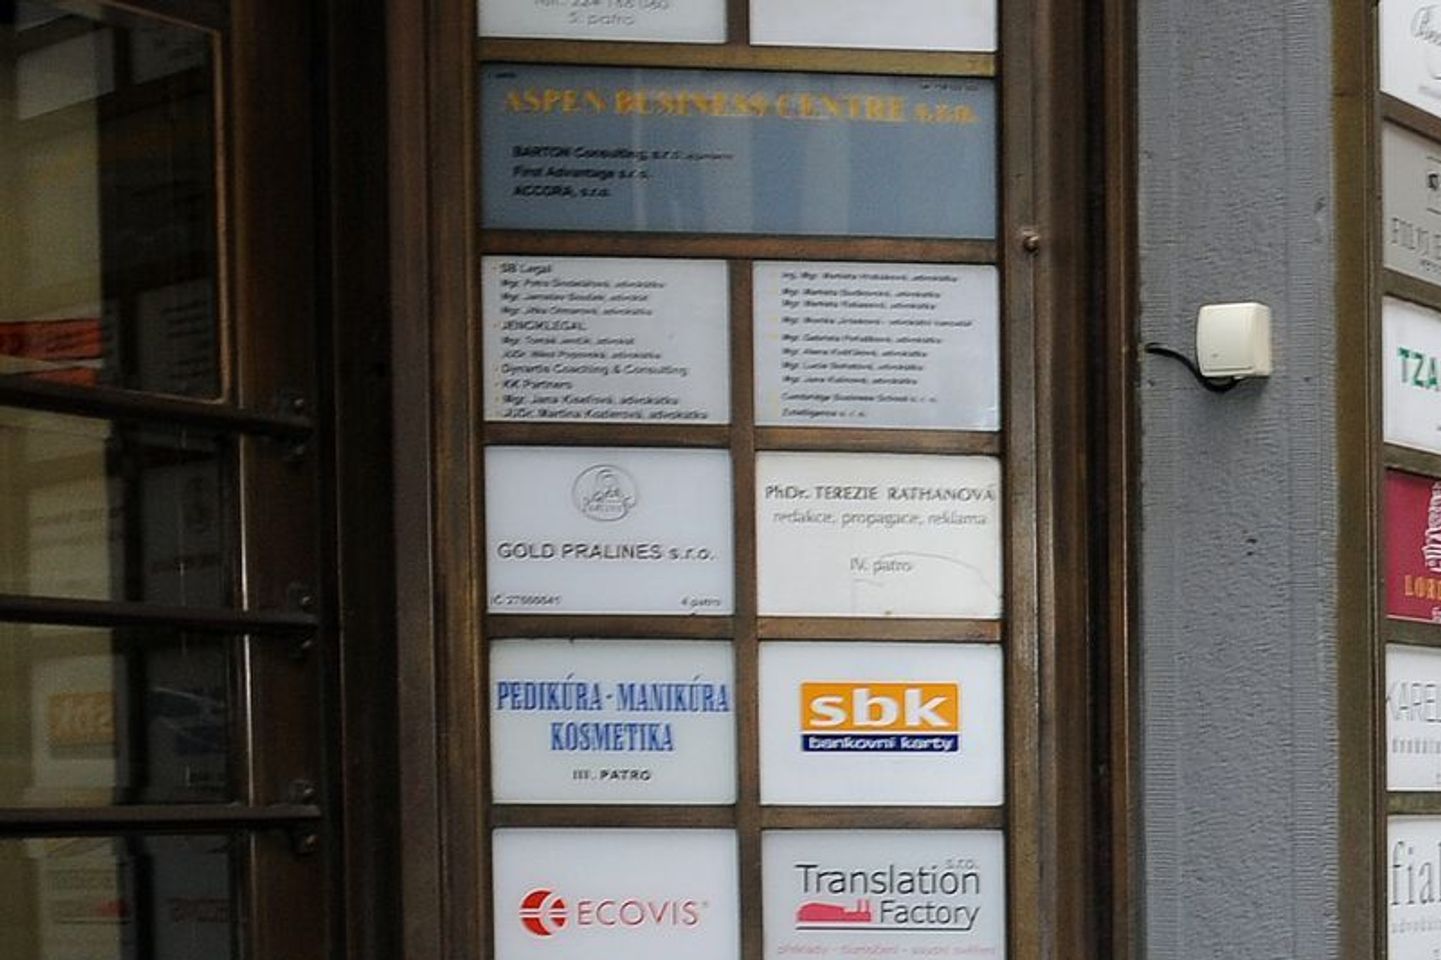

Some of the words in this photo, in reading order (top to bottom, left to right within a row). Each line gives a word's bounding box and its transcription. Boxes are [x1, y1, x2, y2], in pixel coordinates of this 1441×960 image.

[506, 89, 606, 114] ASPEN
[615, 88, 769, 117] BUSINESS
[777, 93, 907, 121] CENTRE
[765, 484, 809, 501] PhDr.
[815, 485, 878, 501] TEREZIE
[887, 483, 998, 502] RATHANOVÁ
[496, 542, 555, 560] GOLD
[561, 542, 662, 561] PRALINES
[668, 546, 716, 561] s.r.o.
[496, 672, 603, 712] PEDIKÚRA
[616, 674, 730, 713] MANIKÚRA
[808, 687, 952, 728] sbk
[550, 721, 674, 752] KOSMETIKA
[900, 736, 954, 752] karty
[600, 769, 652, 782] PATRO
[794, 863, 981, 895] Translation
[577, 900, 699, 927] ECOVIS
[879, 900, 981, 931] Factory
